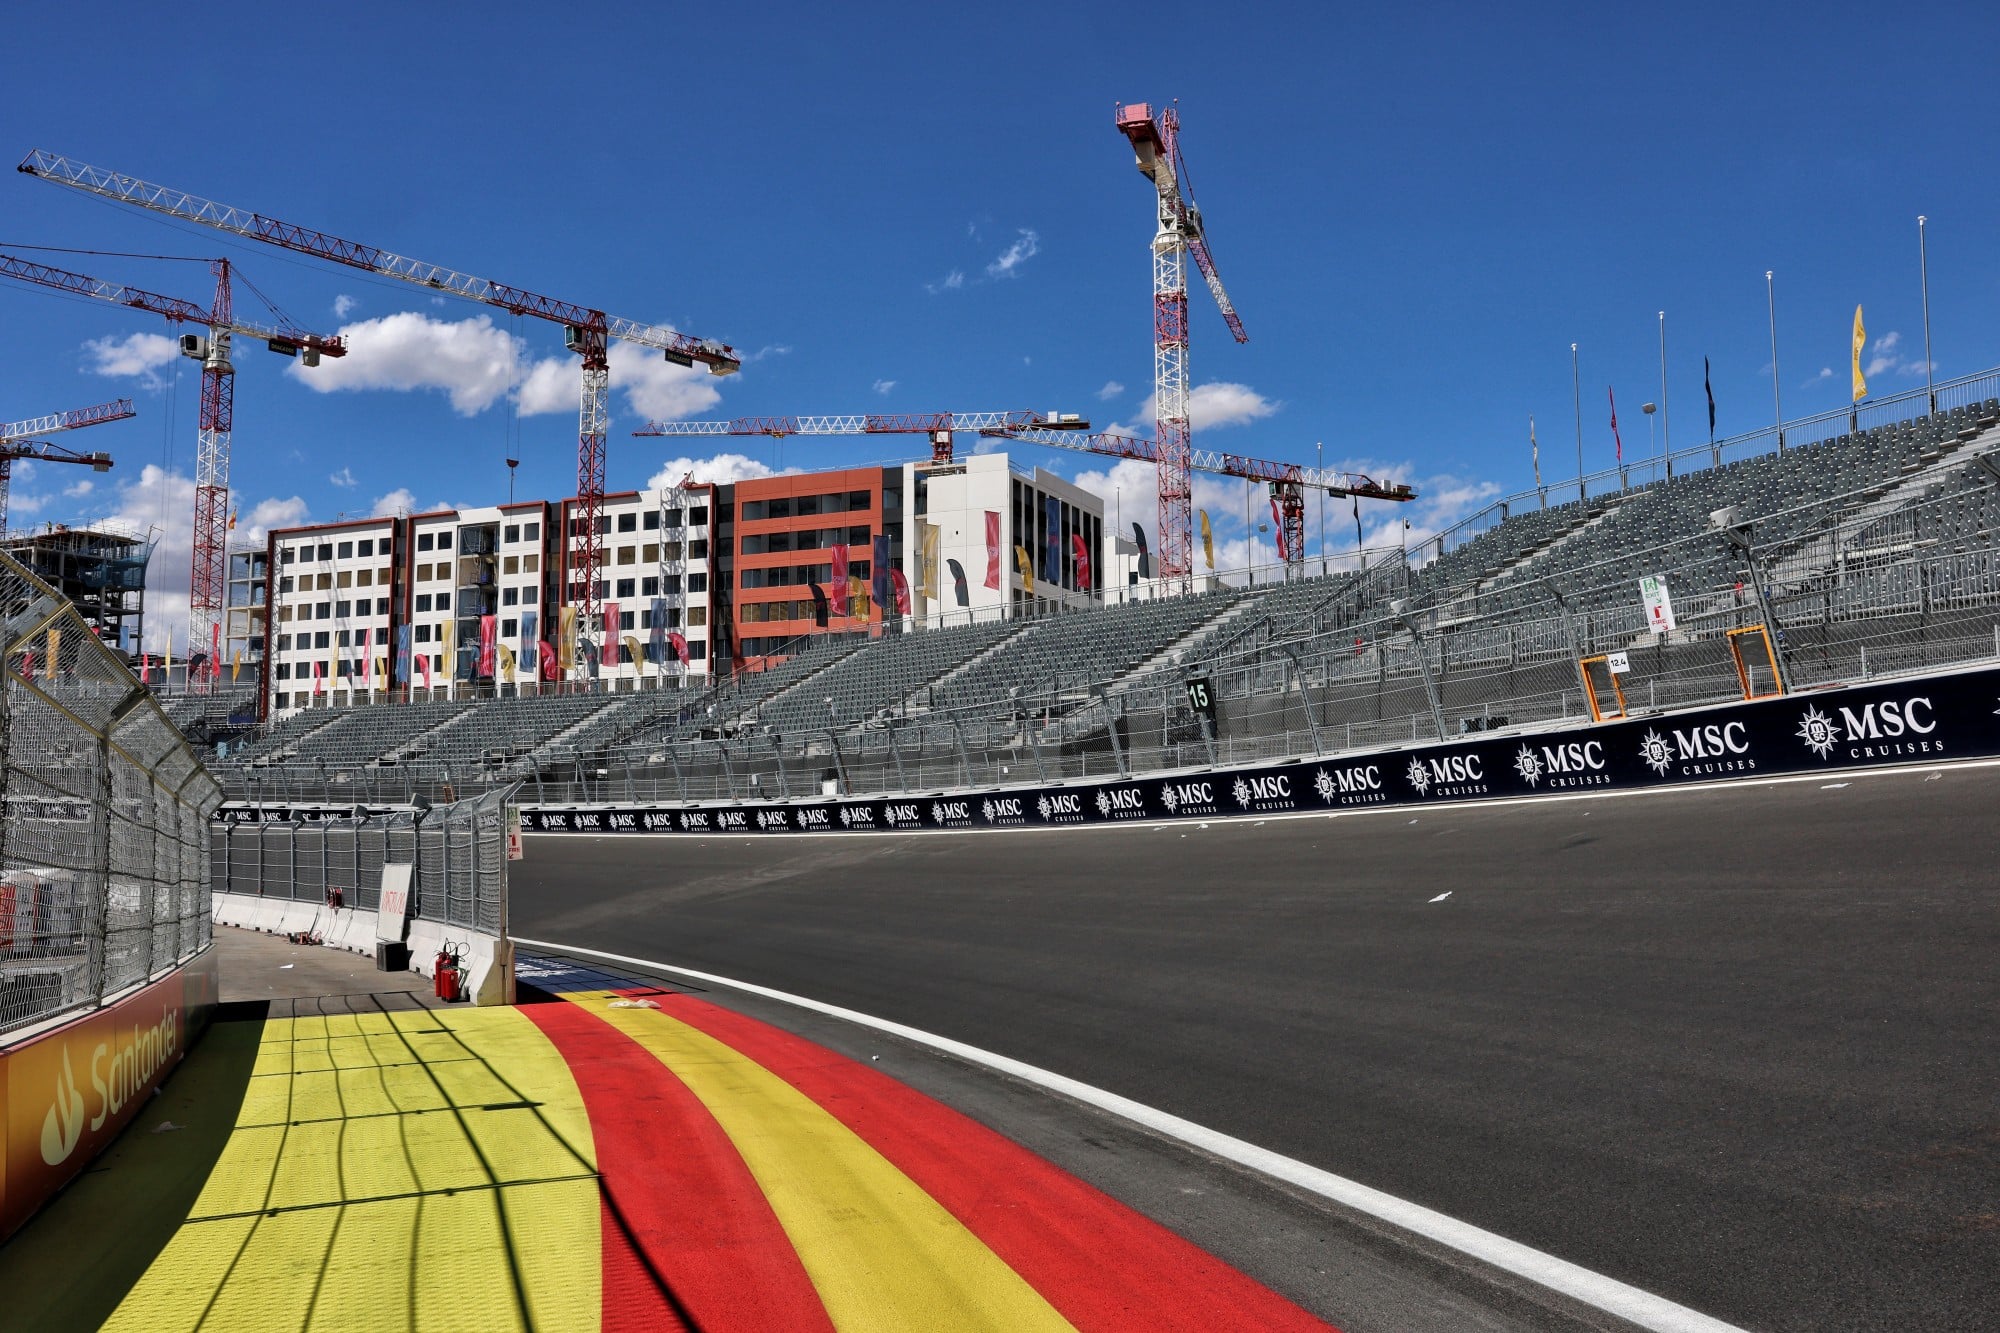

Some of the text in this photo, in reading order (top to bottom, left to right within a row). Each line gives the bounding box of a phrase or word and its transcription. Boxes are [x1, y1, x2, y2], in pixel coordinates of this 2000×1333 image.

[1645, 591, 1660, 599] EXIT
[1611, 658, 1627, 667] 12.4
[1190, 684, 1208, 707] 15
[1838, 698, 1936, 741] MSC
[1672, 722, 1749, 760] MSC
[1851, 740, 1943, 758] CRUISES
[1542, 741, 1605, 773] MSC
[1430, 754, 1482, 783] MSC
[1683, 759, 1755, 775] CRUISES
[1335, 766, 1381, 792] MSC
[1550, 774, 1610, 787] CRUISES
[1177, 782, 1213, 804] MSC
[1250, 776, 1290, 799] MSC
[1437, 784, 1488, 796] CRUISES
[1051, 795, 1081, 813] MSC
[1110, 789, 1142, 809] MSC
[1256, 801, 1295, 810] CRUISES
[1341, 793, 1386, 804] CRUISES
[850, 807, 873, 821] MSC
[895, 805, 919, 820] MSC
[943, 802, 969, 818] MSC
[994, 799, 1022, 816] MSC
[1182, 806, 1217, 814] CRUISES
[236, 811, 251, 820] MSC
[266, 812, 281, 821] MSC
[549, 815, 566, 826] MSC
[582, 815, 599, 826] MSC
[617, 815, 635, 826] MSC
[652, 814, 670, 825] MSC
[689, 813, 708, 825] MSC
[726, 812, 746, 824] MSC
[766, 811, 787, 824] MSC
[806, 809, 828, 823] MSC
[91, 1004, 177, 1131] Santander
